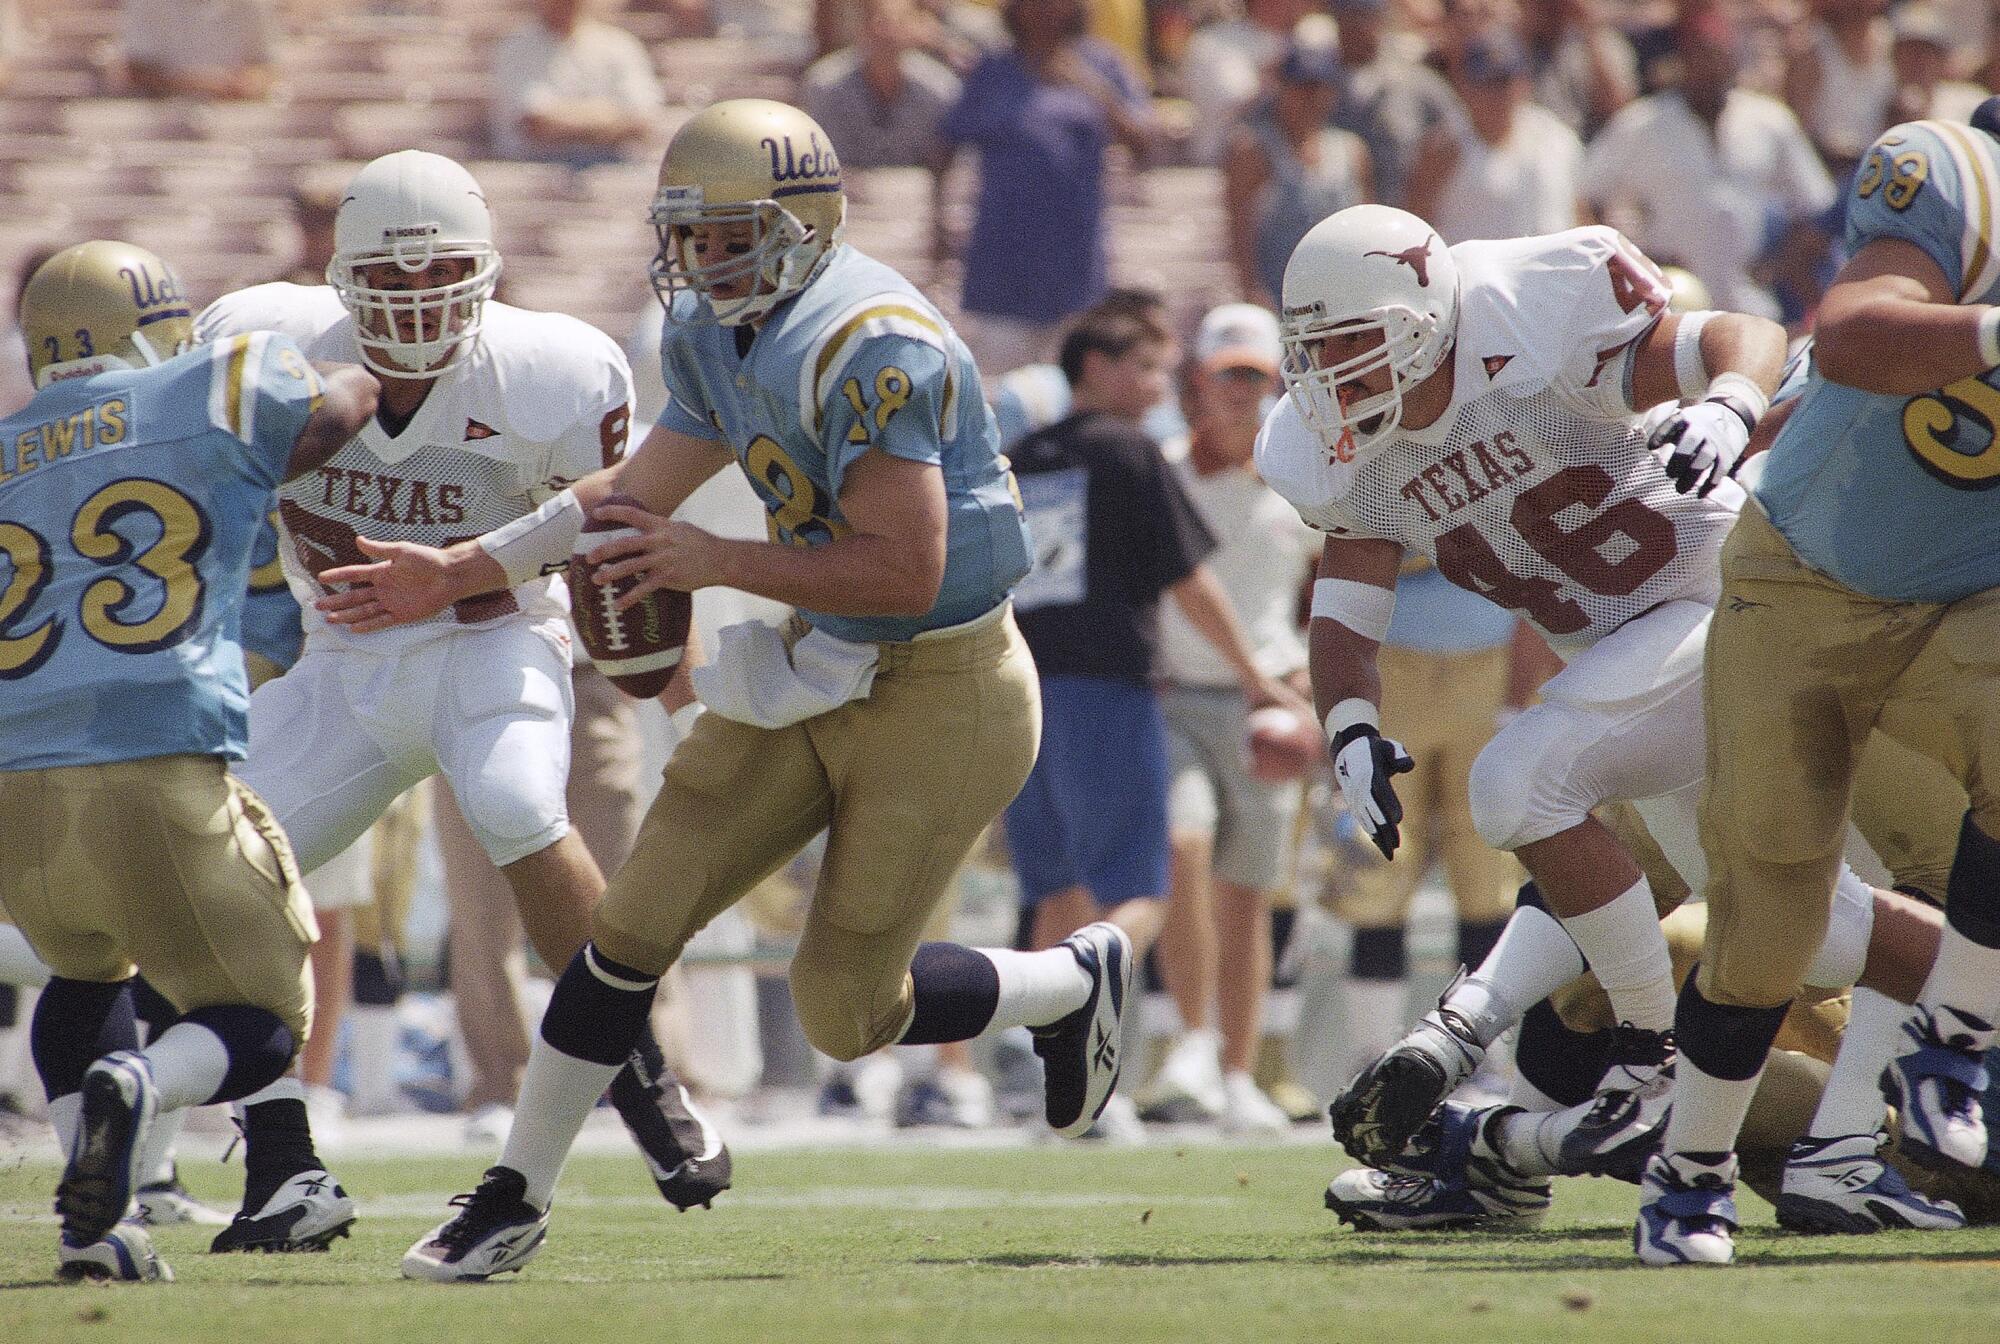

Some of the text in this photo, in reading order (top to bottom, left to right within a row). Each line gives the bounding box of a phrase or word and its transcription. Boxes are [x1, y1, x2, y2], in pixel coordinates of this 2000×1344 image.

[761, 132, 840, 182] Ucla
[319, 466, 465, 525] TEXAS
[1400, 430, 1535, 521] TEXAS
[0, 475, 212, 680] 23
[1434, 463, 1678, 634] 46
